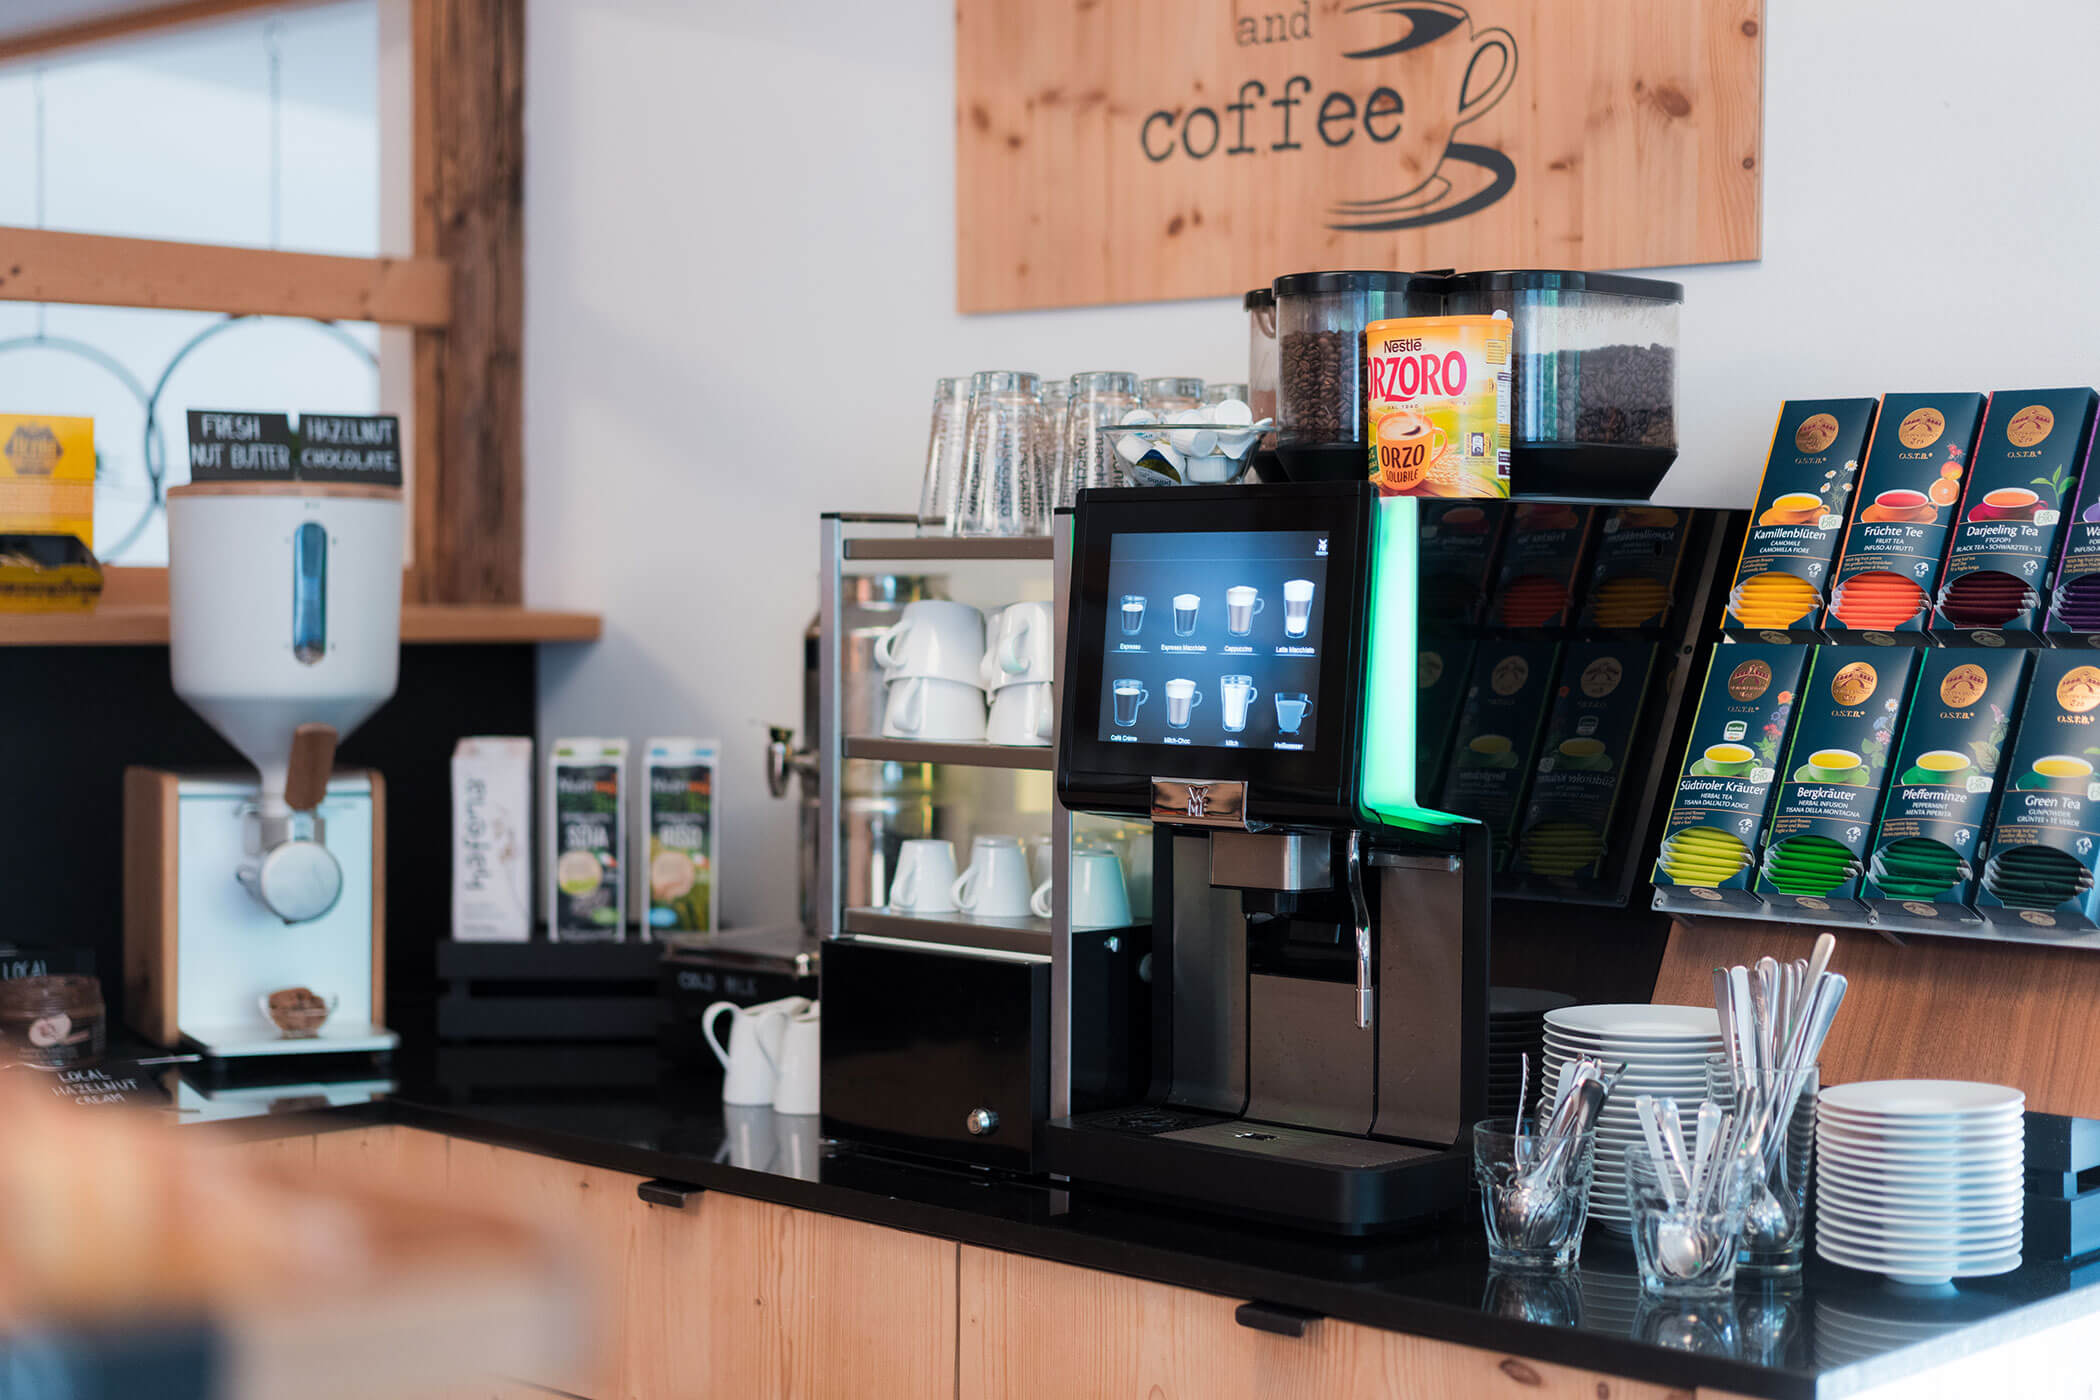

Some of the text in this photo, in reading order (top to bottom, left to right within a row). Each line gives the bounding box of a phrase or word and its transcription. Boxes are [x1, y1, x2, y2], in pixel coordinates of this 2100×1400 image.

[1236, 2, 1311, 46] and
[1140, 75, 1404, 162] coffee
[201, 414, 260, 440] FRESH
[306, 417, 394, 444] HAZELNUT
[192, 443, 290, 471] NUT BUTTER
[302, 448, 397, 471] CHOCOLATE
[1382, 444, 1425, 468] ORZO
[1386, 469, 1418, 483] SOLUBILE
[1754, 528, 1826, 540] Kamillenblüten
[1864, 525, 1923, 538] Früchte Tee
[1966, 524, 2039, 537] Darjeeling Tea
[1680, 780, 1766, 795] Südtiroler Kräuter
[1797, 786, 1856, 800] Bergkräuter
[1902, 788, 1968, 802] Pfefferminze
[2025, 794, 2080, 810] Green Tea
[1823, 808, 1860, 818] MONTAGNA
[58, 1068, 112, 1084] LOCAL
[51, 1079, 138, 1096] HAZELNUT
